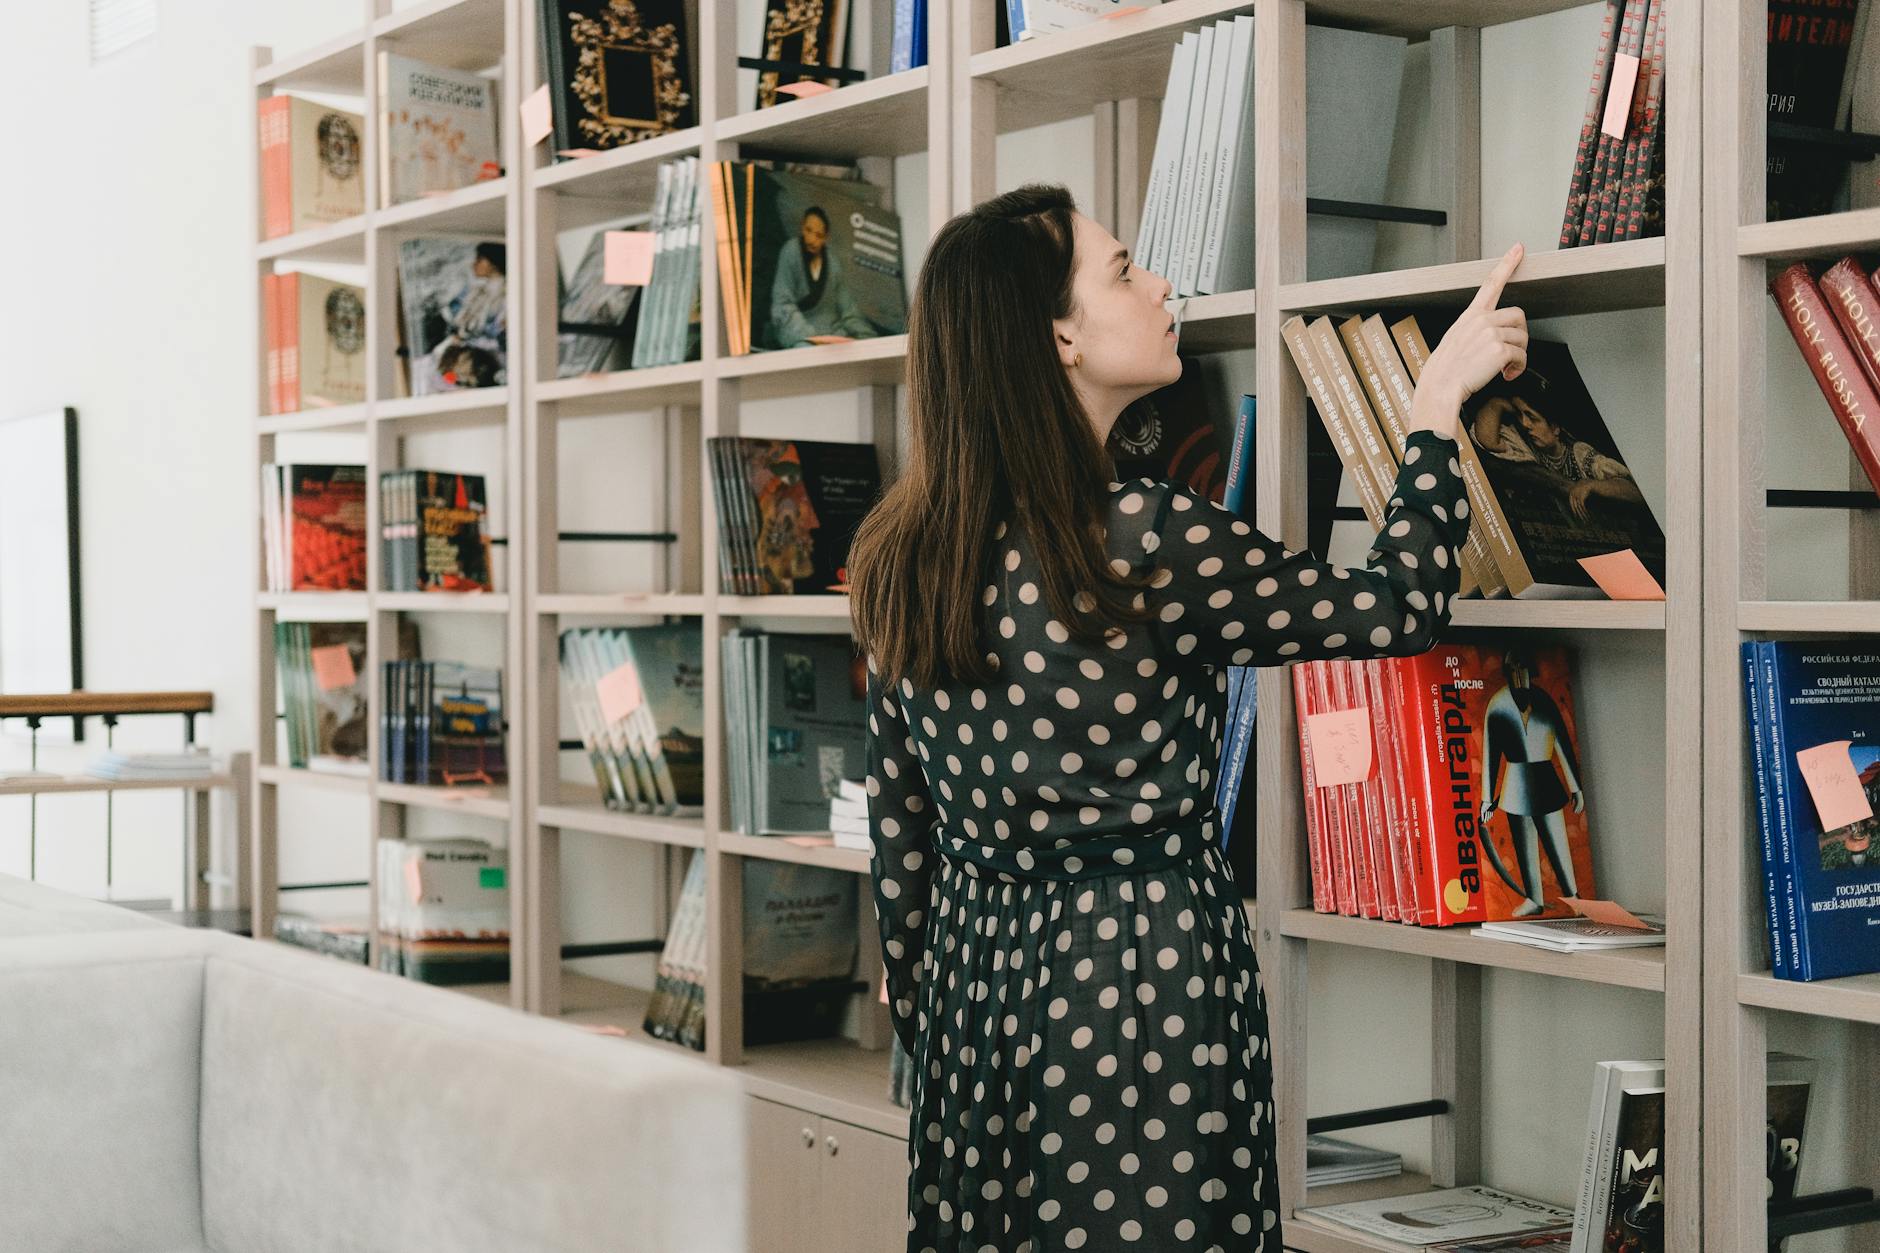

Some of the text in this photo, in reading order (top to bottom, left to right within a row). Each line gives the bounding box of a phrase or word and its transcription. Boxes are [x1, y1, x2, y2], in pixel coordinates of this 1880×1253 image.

[1767, 94, 1796, 113] РИЯ
[1840, 286, 1878, 342] HOLY
[1788, 291, 1866, 433] HOLY RUSSIA
[1229, 414, 1247, 488] Национализм
[1445, 656, 1459, 668] до
[1452, 668, 1460, 677] и
[1802, 653, 1850, 664] РОССИЙСКАЯ
[1454, 679, 1484, 689] после
[1817, 674, 1852, 688] СВОДНЫЙ
[1237, 725, 1246, 740] Art
[1232, 741, 1243, 760] Fine
[1226, 761, 1238, 787] World
[1306, 767, 1314, 797] before
[1440, 684, 1480, 894] авангард
[1770, 895, 1779, 928] КАТАЛОГ
[1787, 897, 1796, 931] КАТАЛОГ
[1772, 931, 1781, 967] СВОДНЫЙ
[1790, 934, 1799, 969] СВОДНЫЙ
